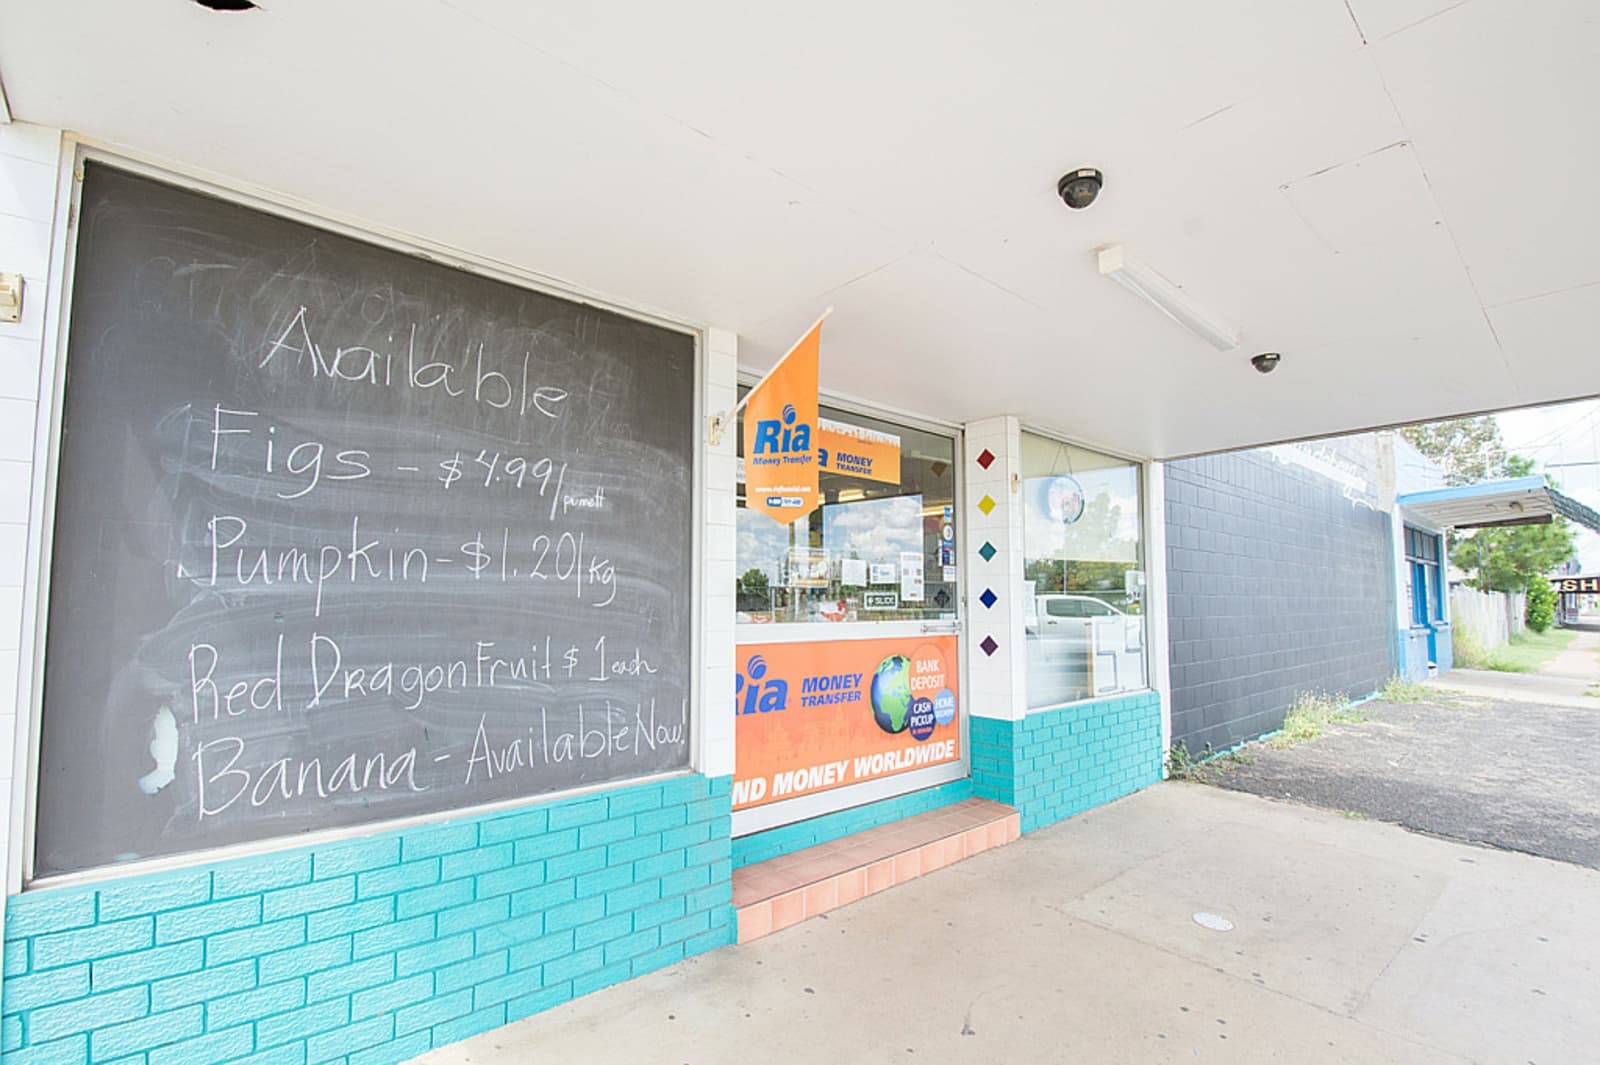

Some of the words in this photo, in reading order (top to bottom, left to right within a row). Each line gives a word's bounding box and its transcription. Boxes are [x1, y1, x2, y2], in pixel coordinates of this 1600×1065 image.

[259, 306, 568, 417] Available
[752, 404, 811, 454] Ria
[211, 403, 371, 499] Figs
[836, 452, 873, 467] MONEY
[753, 457, 780, 466] Money
[782, 455, 812, 465] Transfer
[836, 463, 872, 475] TRANSFER
[916, 659, 940, 674] BANK
[188, 634, 283, 724] Red
[801, 673, 863, 694] MONEY
[911, 674, 945, 691] DEPOSIT
[800, 690, 862, 708] TRANSFER
[913, 701, 932, 714] CASH
[910, 713, 934, 727] PICKUP
[191, 736, 429, 820] Banana
[465, 700, 628, 785] Available
[772, 759, 849, 797] MONEY
[853, 740, 956, 777] WORLDWIDE
